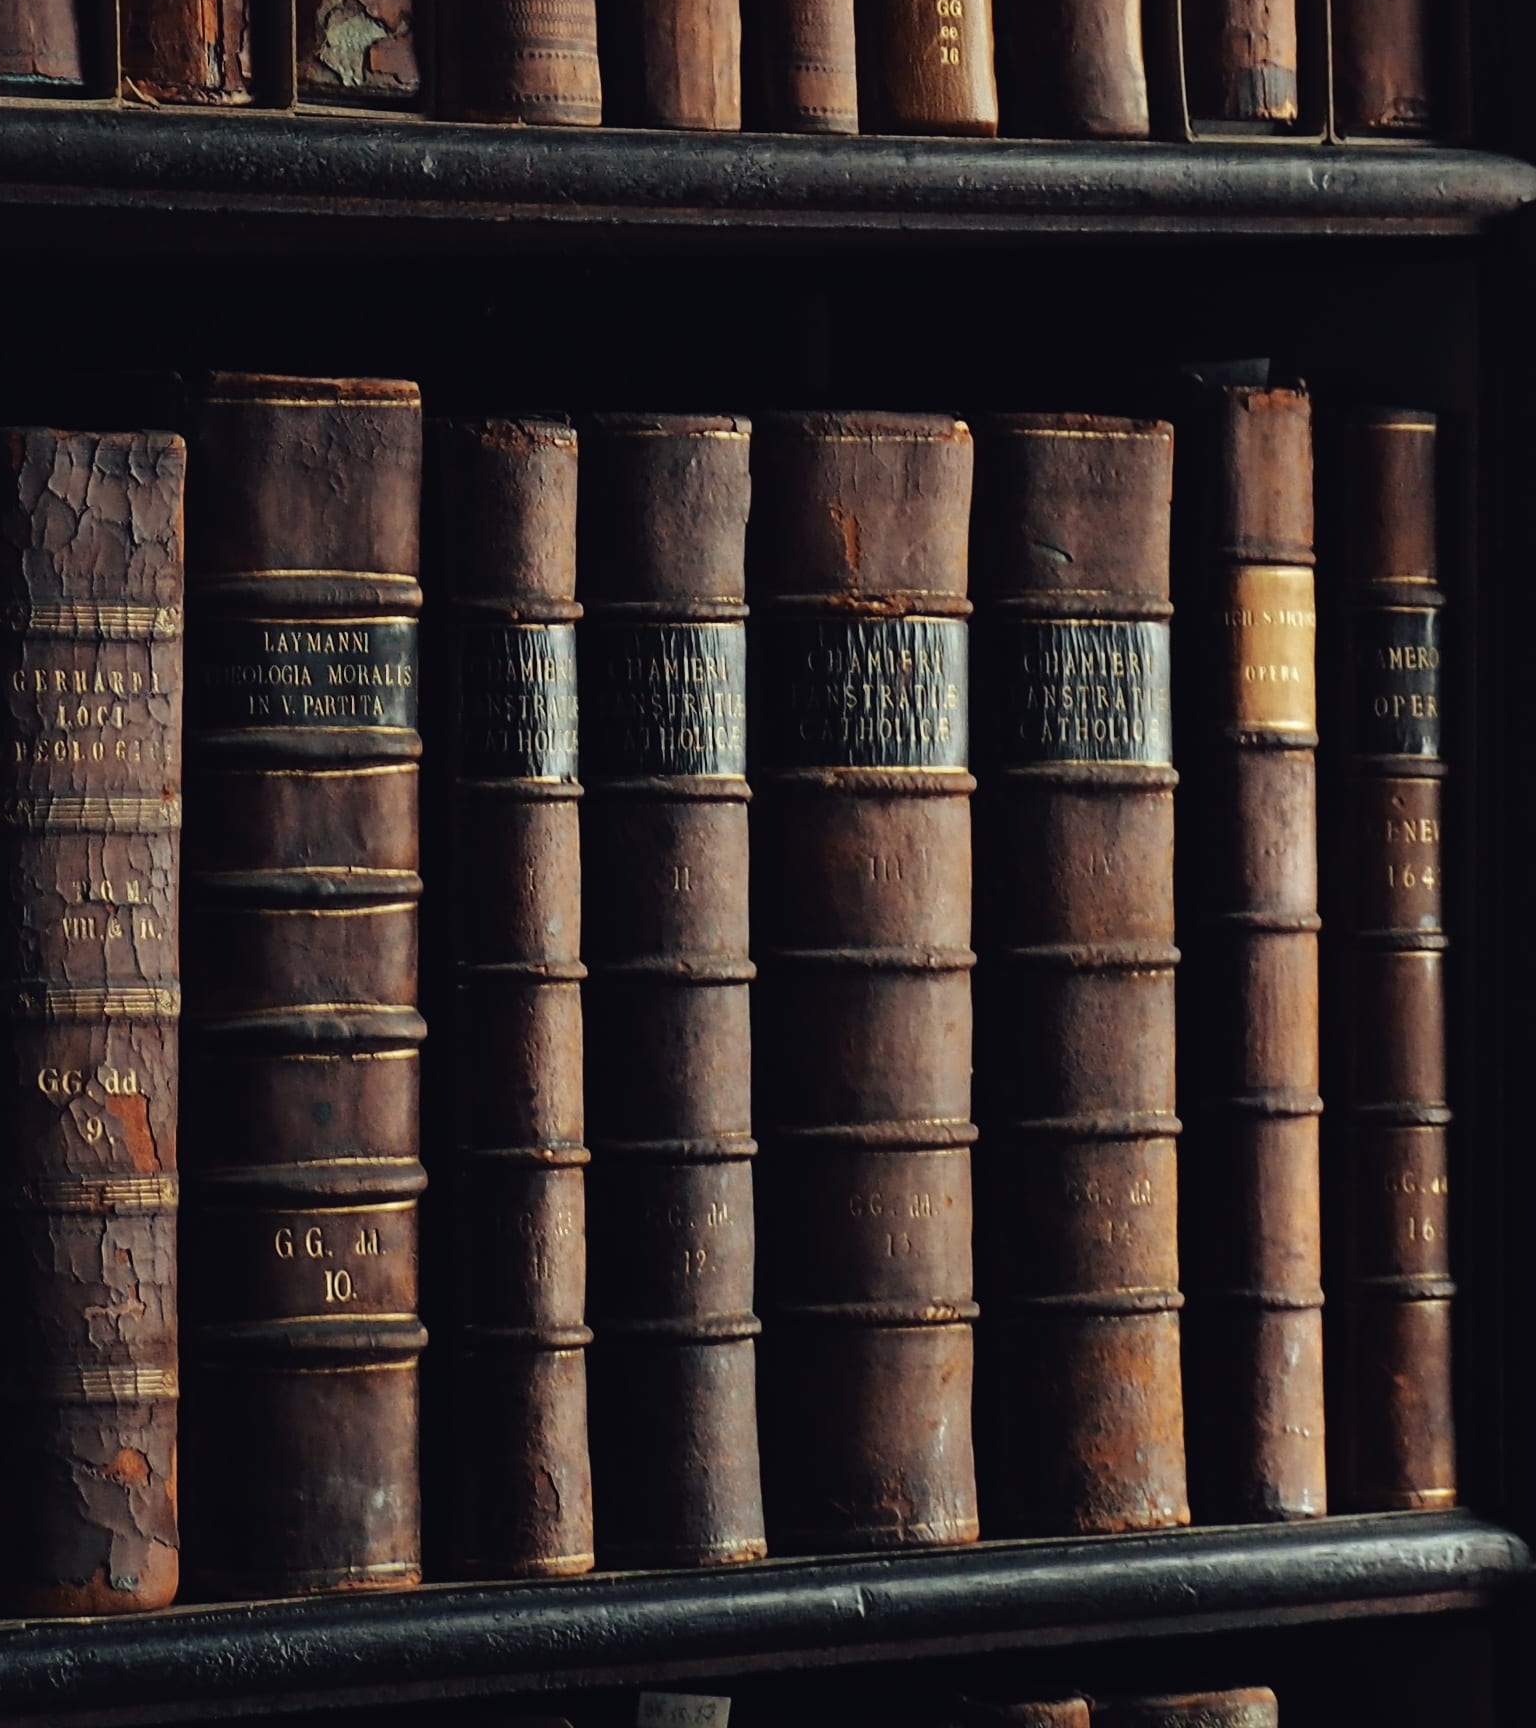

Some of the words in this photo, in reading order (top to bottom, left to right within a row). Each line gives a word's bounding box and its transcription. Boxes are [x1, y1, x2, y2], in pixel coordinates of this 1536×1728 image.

[264, 631, 371, 655] LAYMANNI
[13, 670, 162, 696] GERHARDI
[328, 664, 414, 688] MORALIS
[56, 705, 125, 730] LOCI
[1374, 694, 1439, 719] OPER
[38, 1068, 95, 1097] GG.
[104, 1069, 149, 1097] dd.
[85, 1116, 116, 1145] 9.
[275, 1227, 335, 1260] GG.
[355, 1229, 387, 1258] dd.
[324, 1270, 359, 1303] 10.
